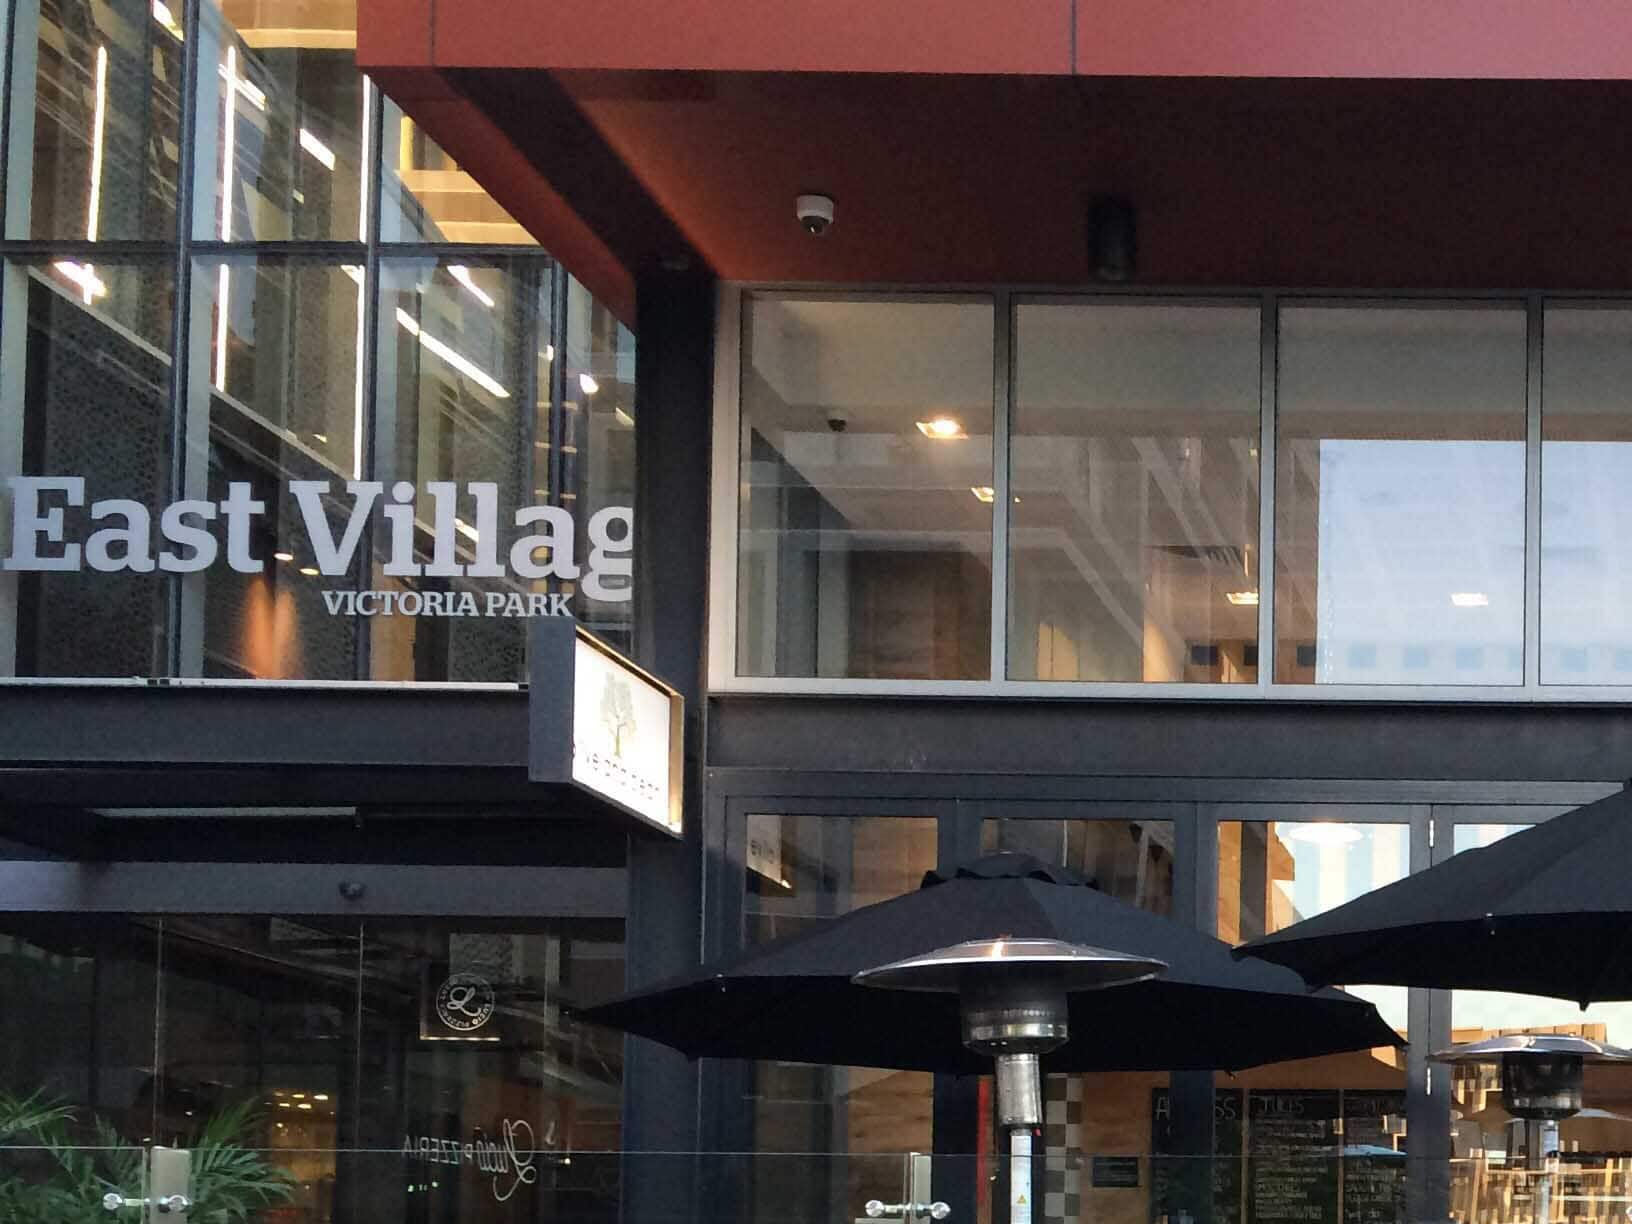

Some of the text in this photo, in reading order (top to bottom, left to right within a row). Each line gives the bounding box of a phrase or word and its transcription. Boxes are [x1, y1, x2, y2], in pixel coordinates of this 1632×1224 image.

[3, 476, 634, 602] East Villag
[321, 590, 573, 617] VICTORIA PARK
